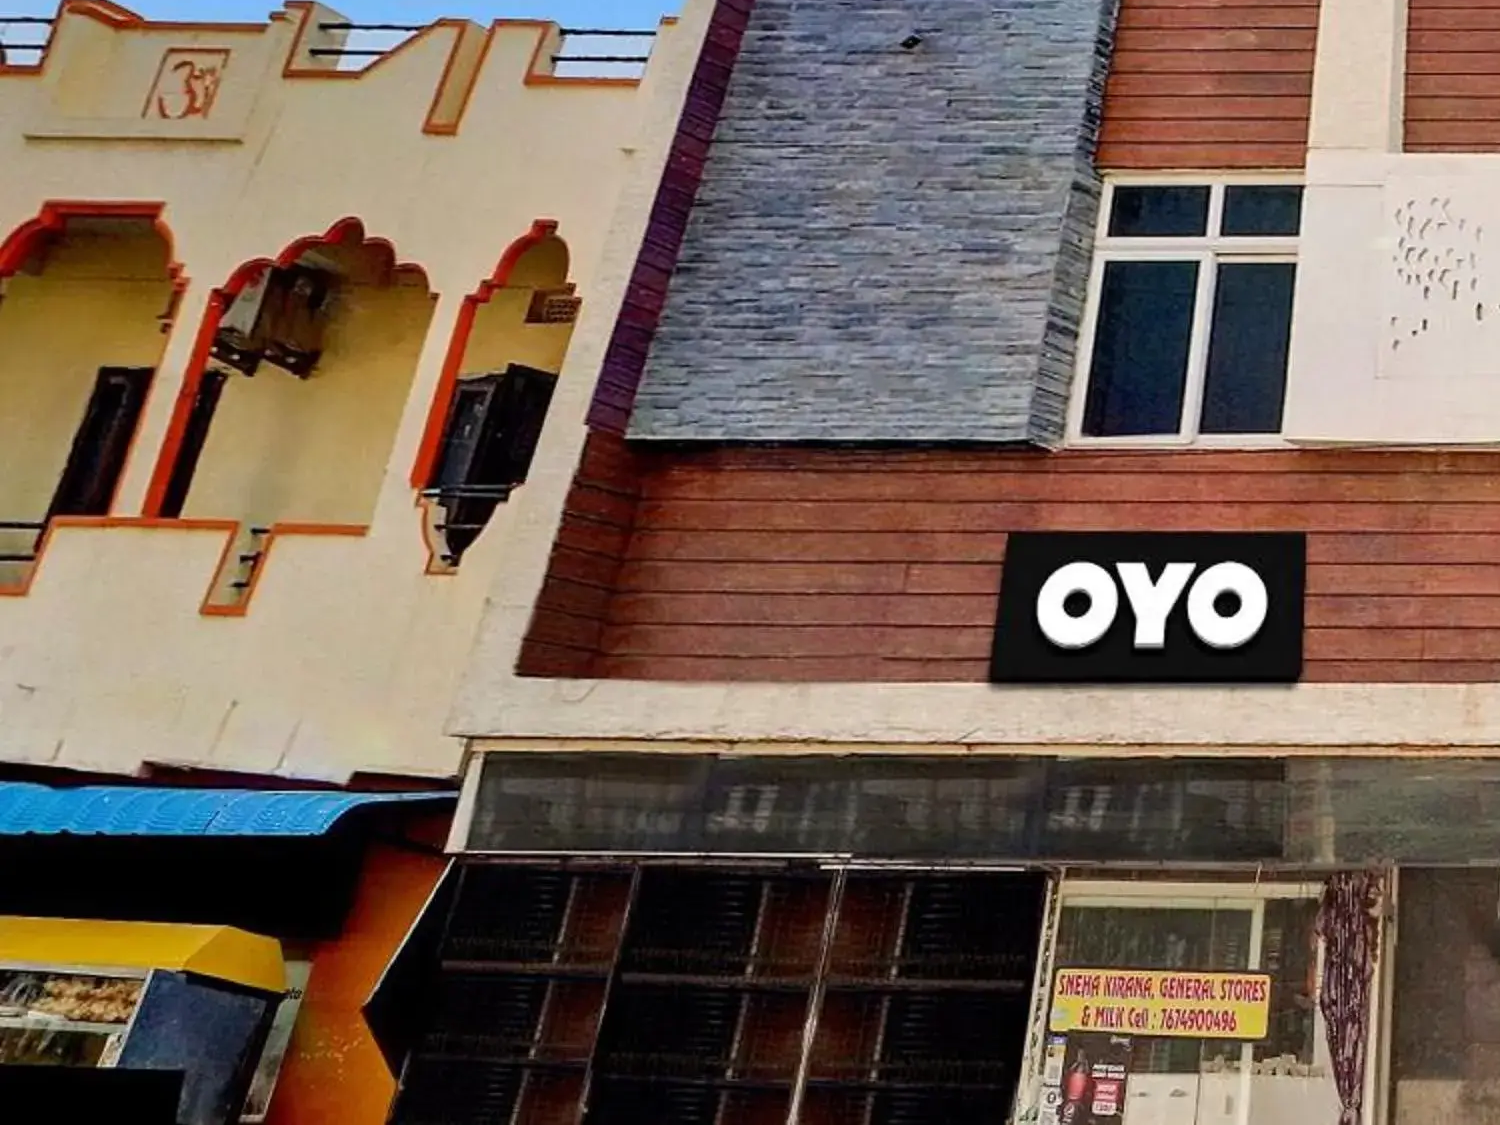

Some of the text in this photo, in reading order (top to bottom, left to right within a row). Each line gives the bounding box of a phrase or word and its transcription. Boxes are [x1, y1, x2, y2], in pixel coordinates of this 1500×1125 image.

[1036, 561, 1268, 649] OYO
[1058, 974, 1101, 997] SNEHA
[1159, 977, 1216, 1001] GENERAL
[1219, 979, 1267, 1003] STORES
[1081, 1005, 1091, 1027] &
[1094, 1006, 1125, 1028] MILK
[1128, 1007, 1149, 1028] Cell
